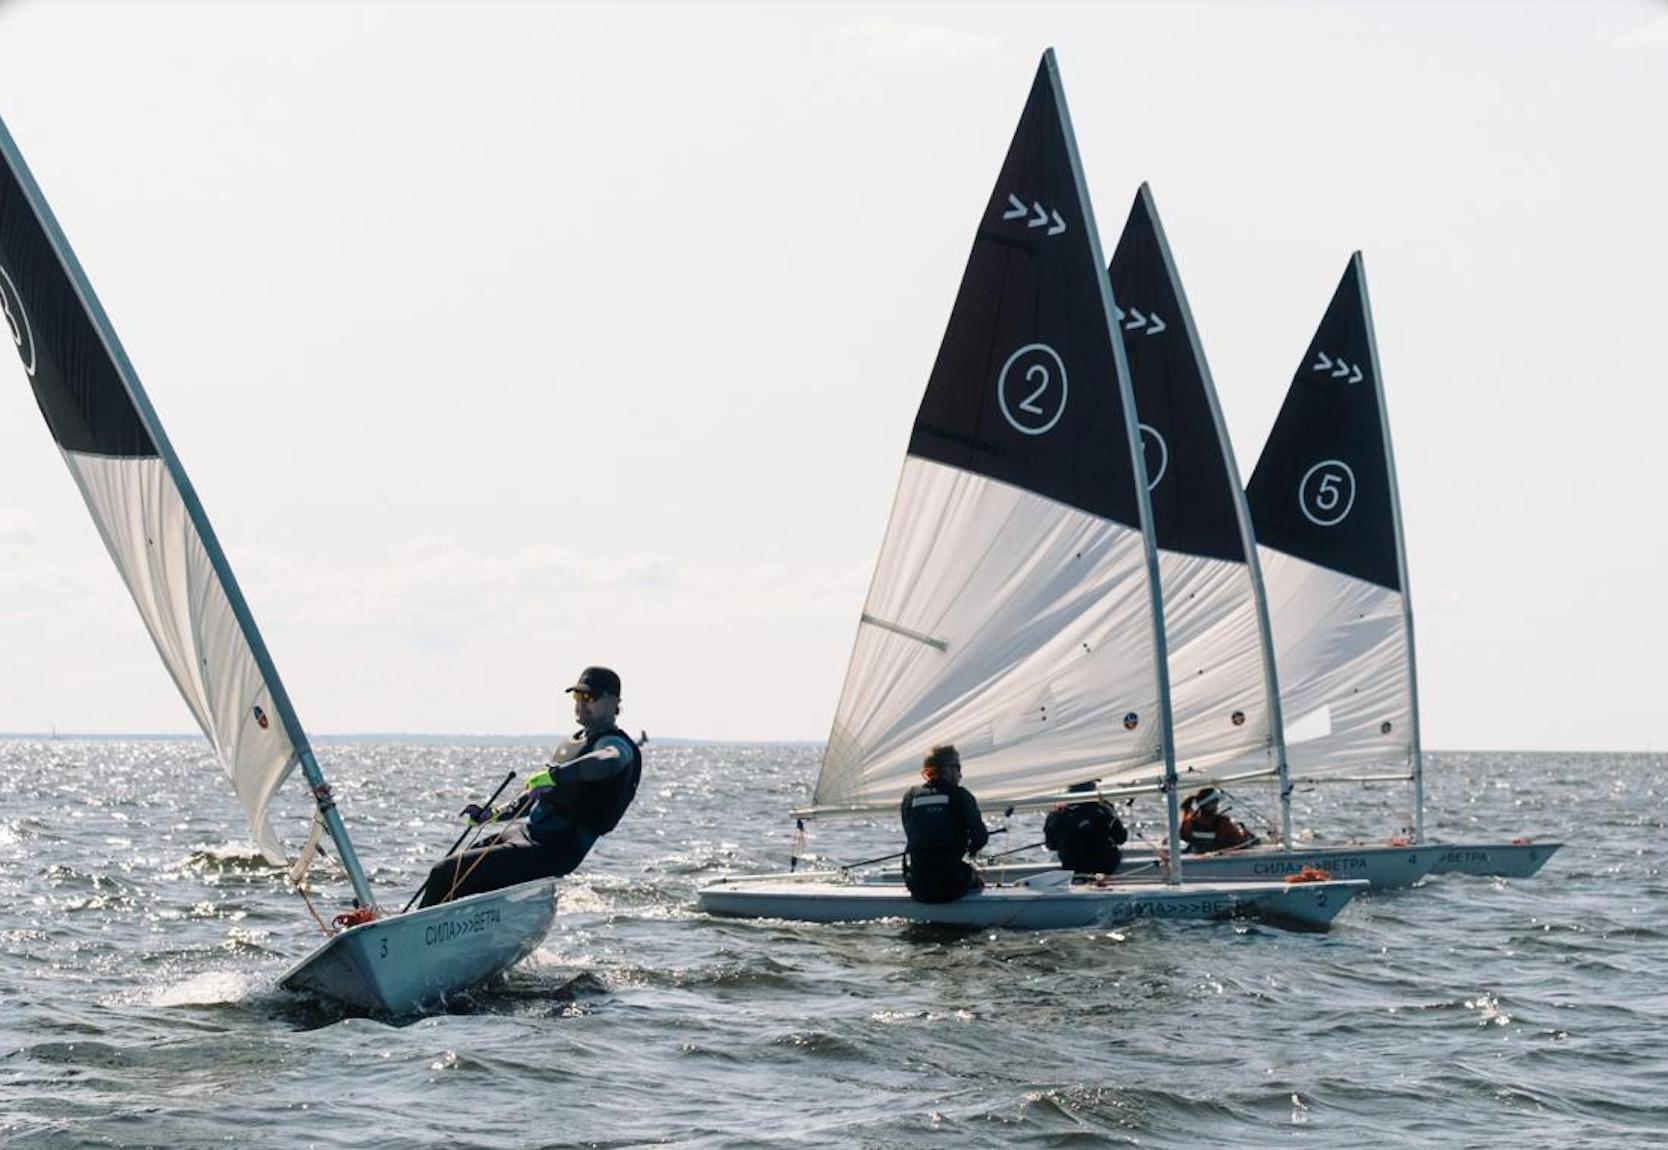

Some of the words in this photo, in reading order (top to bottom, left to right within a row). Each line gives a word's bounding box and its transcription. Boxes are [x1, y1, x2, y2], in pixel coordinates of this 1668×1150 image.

[1018, 364, 1050, 415] 2
[1316, 474, 1343, 510] 5
[1317, 893, 1328, 908] 2
[380, 937, 389, 959] 3
